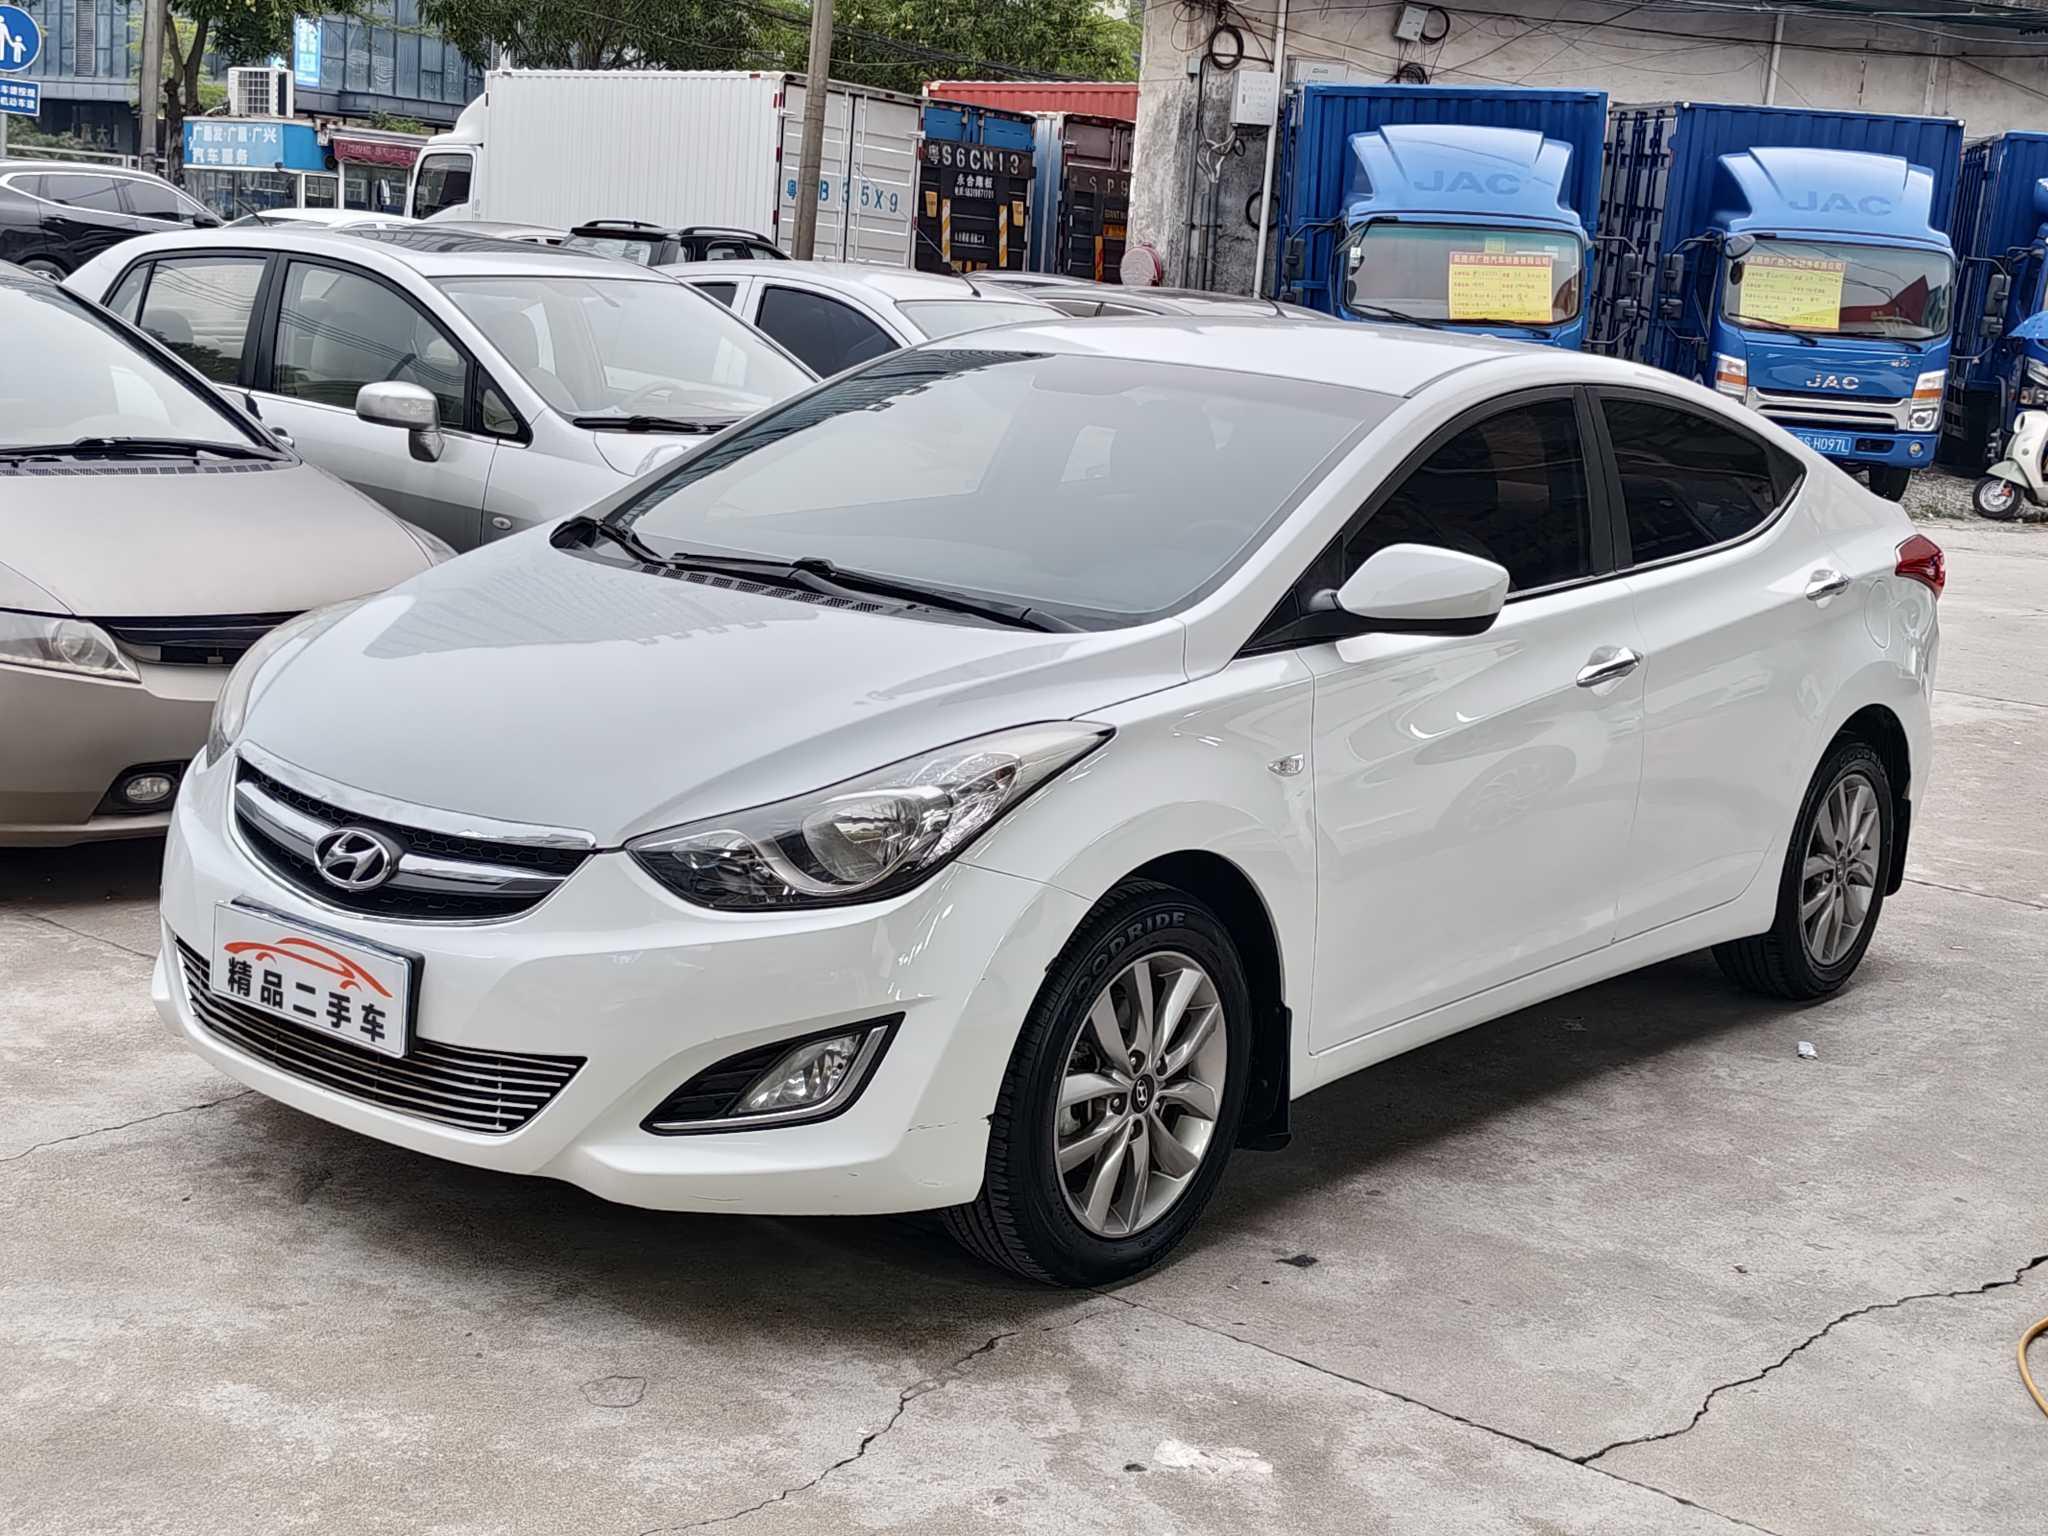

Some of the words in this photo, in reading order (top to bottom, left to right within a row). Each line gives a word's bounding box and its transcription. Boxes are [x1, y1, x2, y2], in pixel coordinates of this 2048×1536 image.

[1413, 170, 1521, 195] JAC
[1788, 190, 1893, 217] JAC
[1806, 374, 1859, 389] JAC
[1070, 911, 1186, 1003] OODRIDE
[227, 956, 386, 1043] 精品二手车
